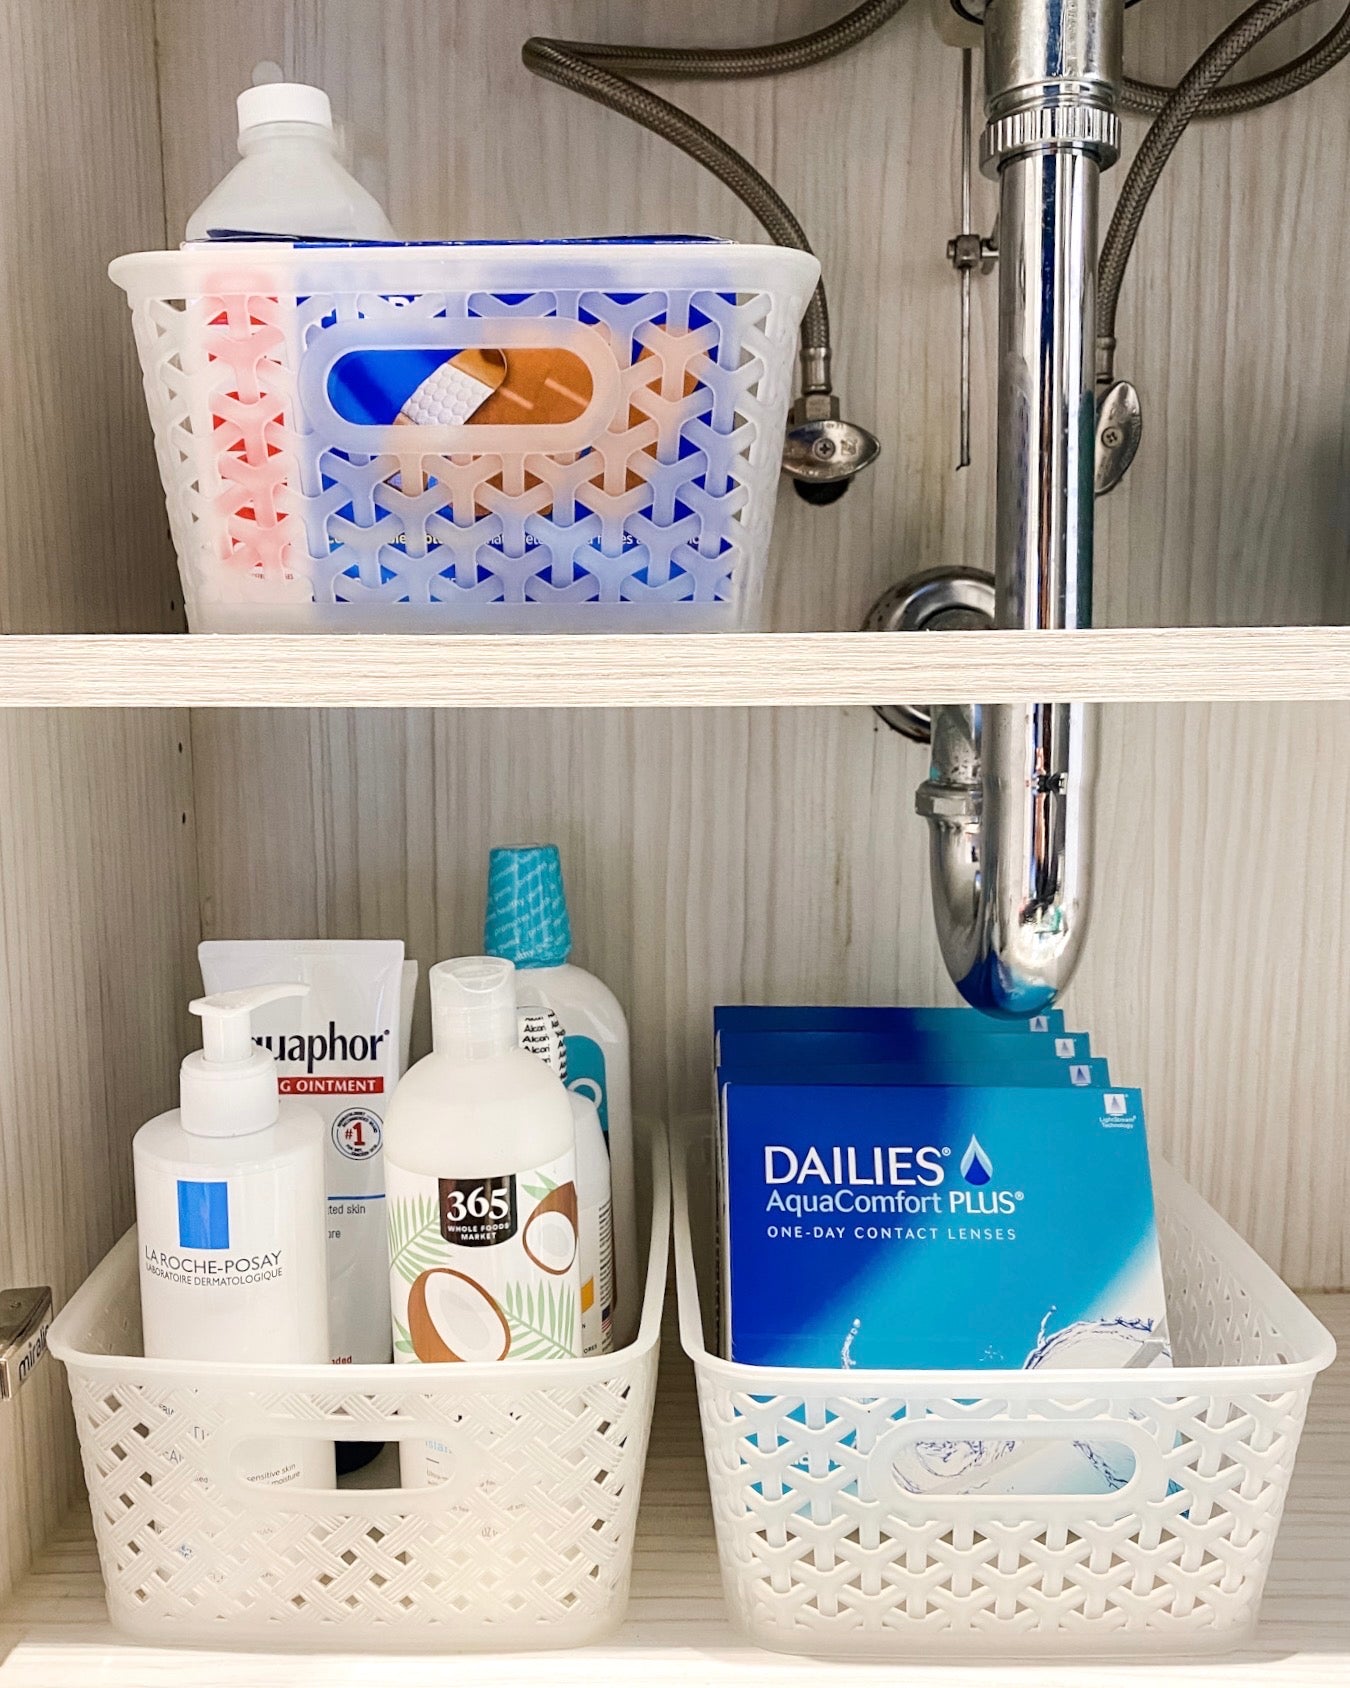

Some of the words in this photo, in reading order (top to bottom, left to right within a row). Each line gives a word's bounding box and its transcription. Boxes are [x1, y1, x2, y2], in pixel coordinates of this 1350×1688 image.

[524, 1024, 546, 1032] Alcon
[522, 1035, 550, 1043] Alcon
[252, 1021, 384, 1073] uaphor
[296, 1080, 377, 1092] OINTMENT
[345, 1121, 365, 1146] #1
[328, 1204, 344, 1214] ted
[346, 1204, 366, 1214] skin
[446, 1186, 509, 1222] 365
[766, 1189, 943, 1217] AquaComfort
[447, 1225, 478, 1233] WHOLE
[481, 1222, 509, 1232] FOODS
[767, 1226, 846, 1239] ONE-DAY
[854, 1226, 939, 1240] CONTACT
[948, 1228, 1016, 1240] LENSES
[461, 1232, 497, 1241] MARKET
[145, 1245, 159, 1264] LA
[160, 1250, 282, 1275] ROCHE-POSAY
[146, 1261, 192, 1285] LABORATOIRE
[194, 1267, 283, 1286] DERMATOLOGIQUE
[282, 1463, 297, 1475] skin
